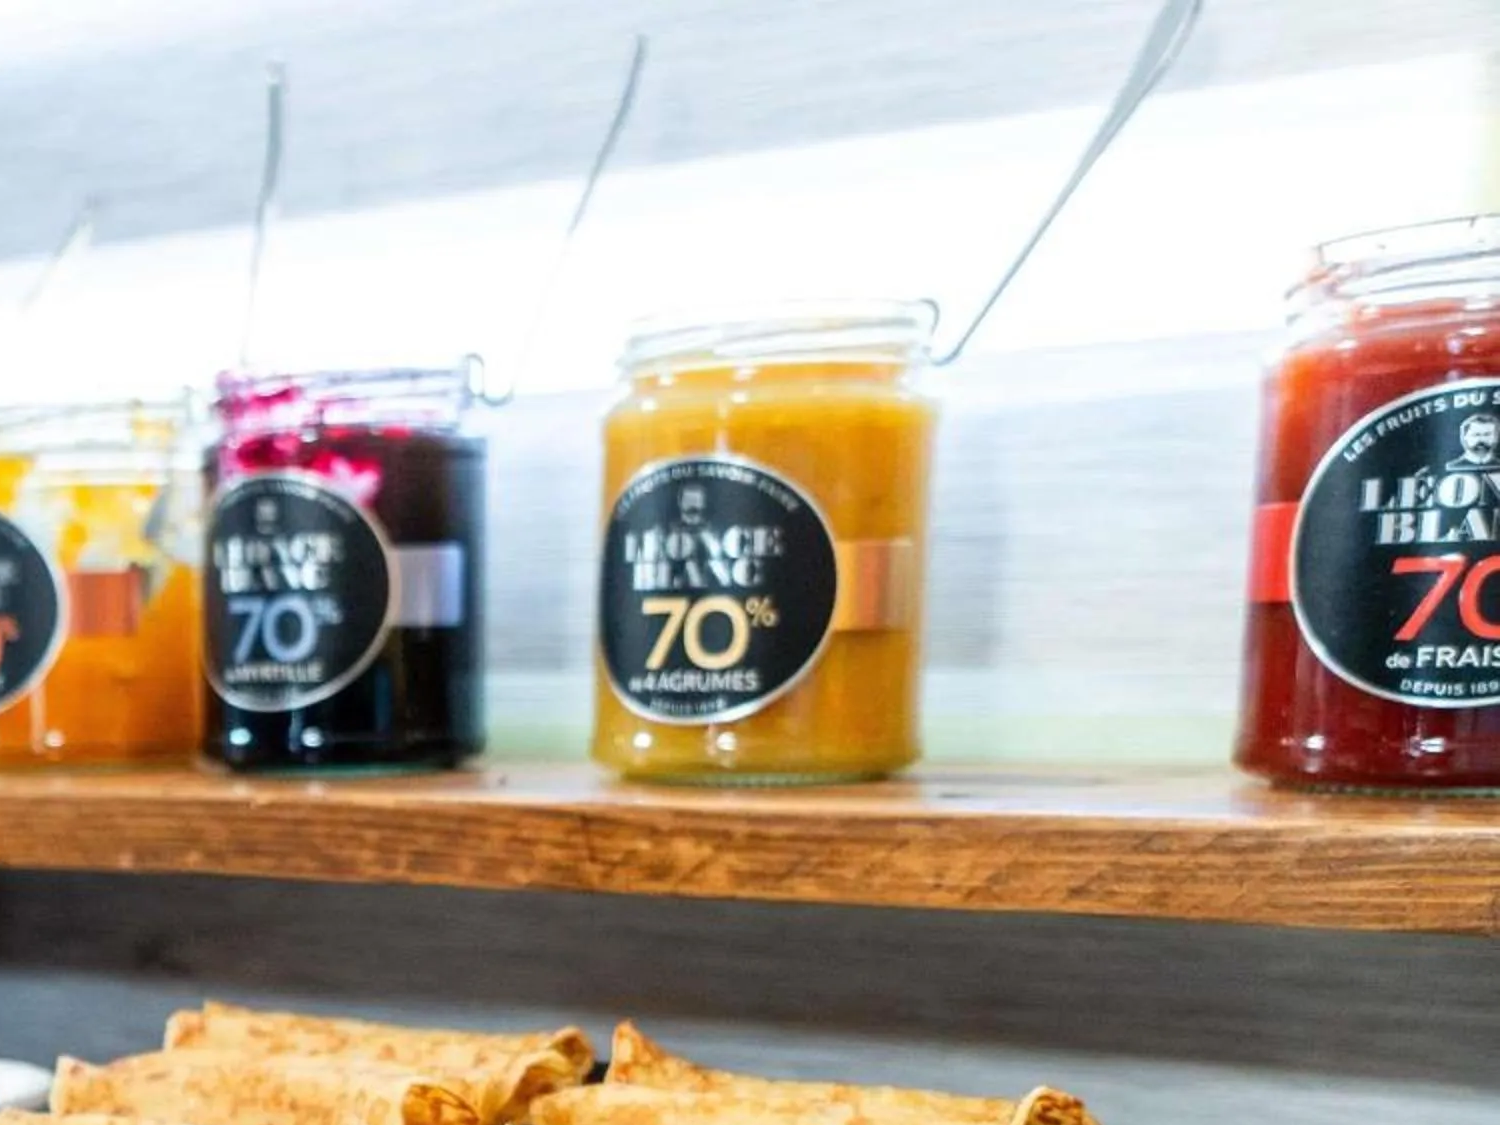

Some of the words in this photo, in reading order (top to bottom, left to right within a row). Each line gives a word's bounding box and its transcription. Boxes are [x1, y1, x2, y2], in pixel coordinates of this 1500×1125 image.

[1343, 430, 1375, 464] LES
[1376, 397, 1448, 439] FRUITS
[1453, 391, 1488, 409] DU
[642, 595, 778, 670] 70%
[1386, 653, 1411, 670] de
[1400, 678, 1465, 698] DEPUIS
